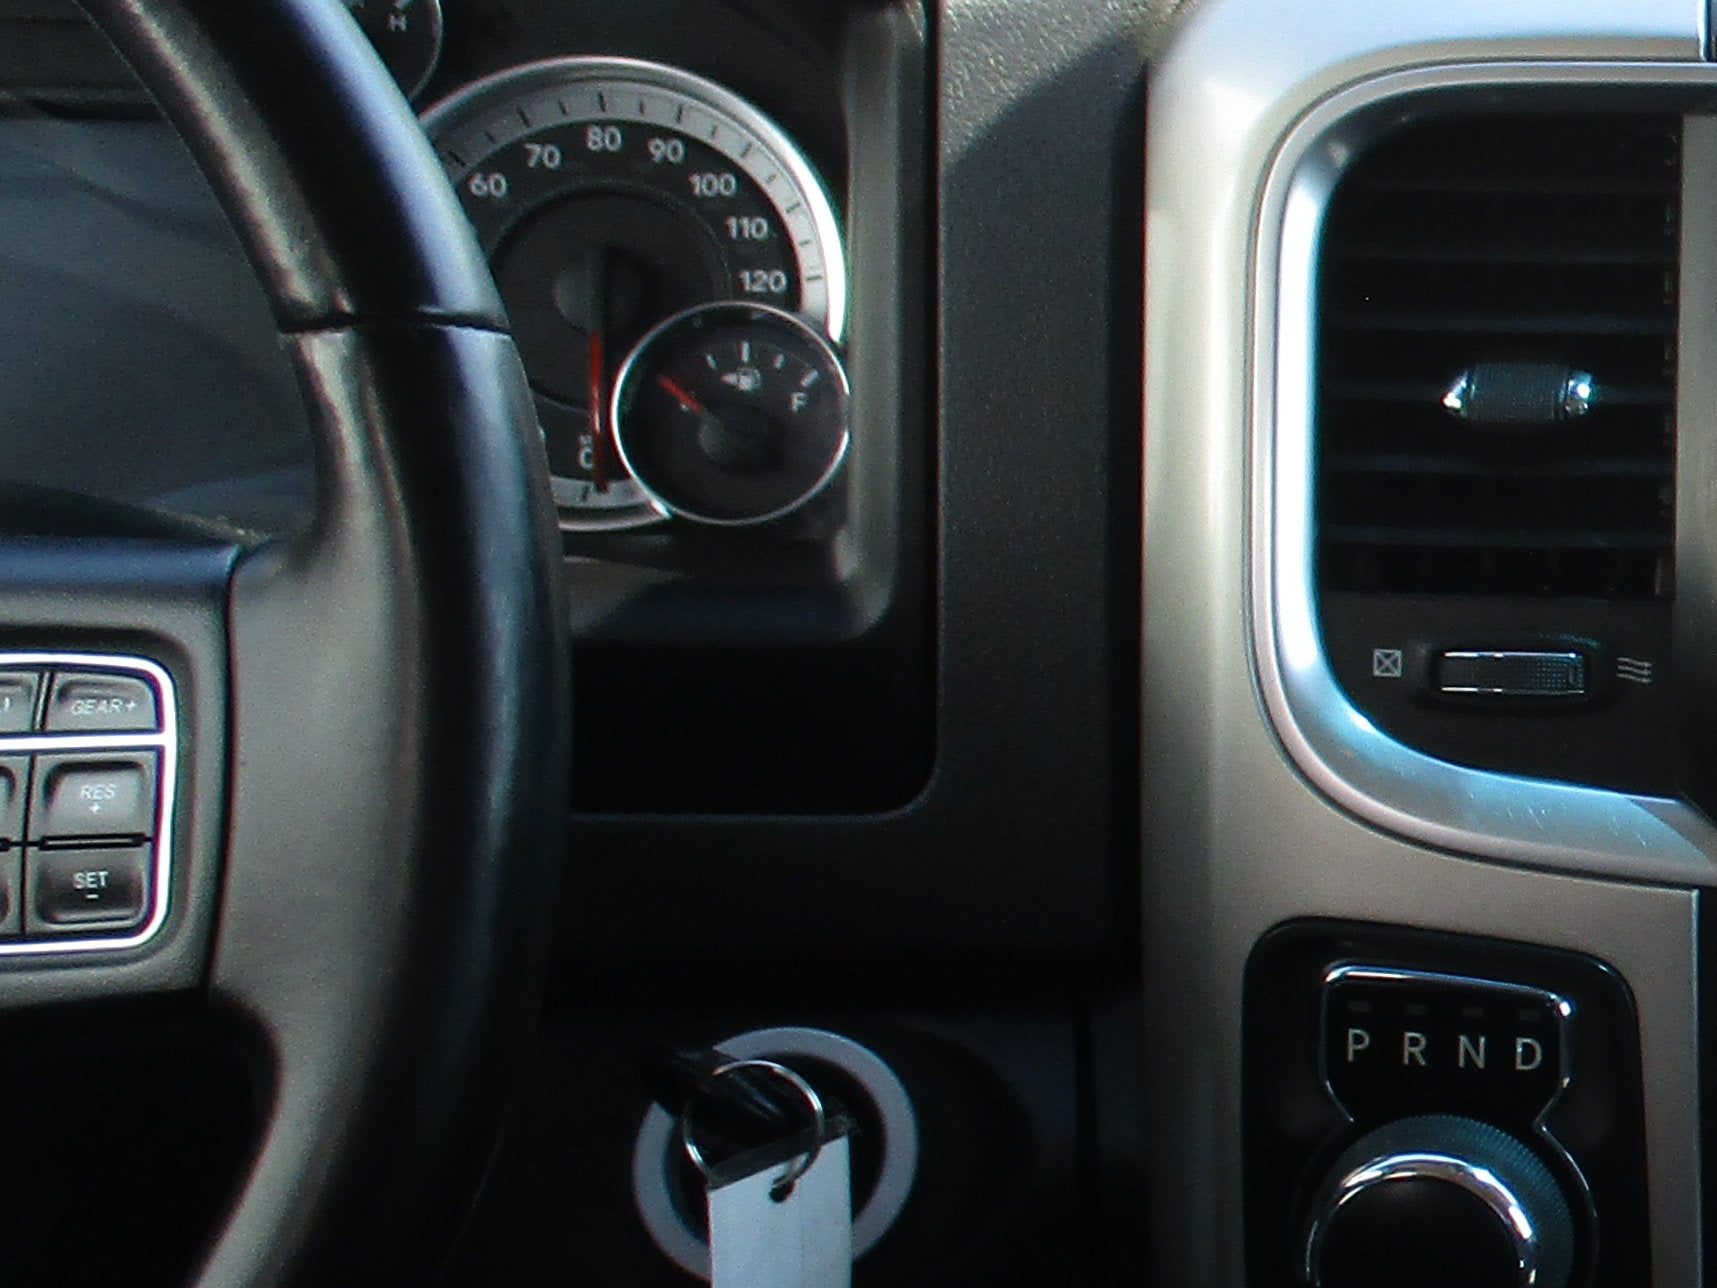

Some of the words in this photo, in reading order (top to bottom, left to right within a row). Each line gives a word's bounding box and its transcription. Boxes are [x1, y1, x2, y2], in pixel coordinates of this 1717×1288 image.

[586, 125, 622, 151] 80
[648, 138, 685, 163] 90
[525, 143, 561, 169] 70
[470, 173, 508, 198] 60
[689, 172, 737, 197] 100
[726, 216, 769, 240] 110
[740, 269, 788, 293] 120
[791, 391, 808, 412] F
[79, 783, 117, 800] RES
[73, 870, 109, 889] SET
[1347, 1028, 1370, 1062] P
[1403, 1031, 1427, 1066] R
[1458, 1034, 1486, 1069] N
[1515, 1037, 1542, 1071] D
